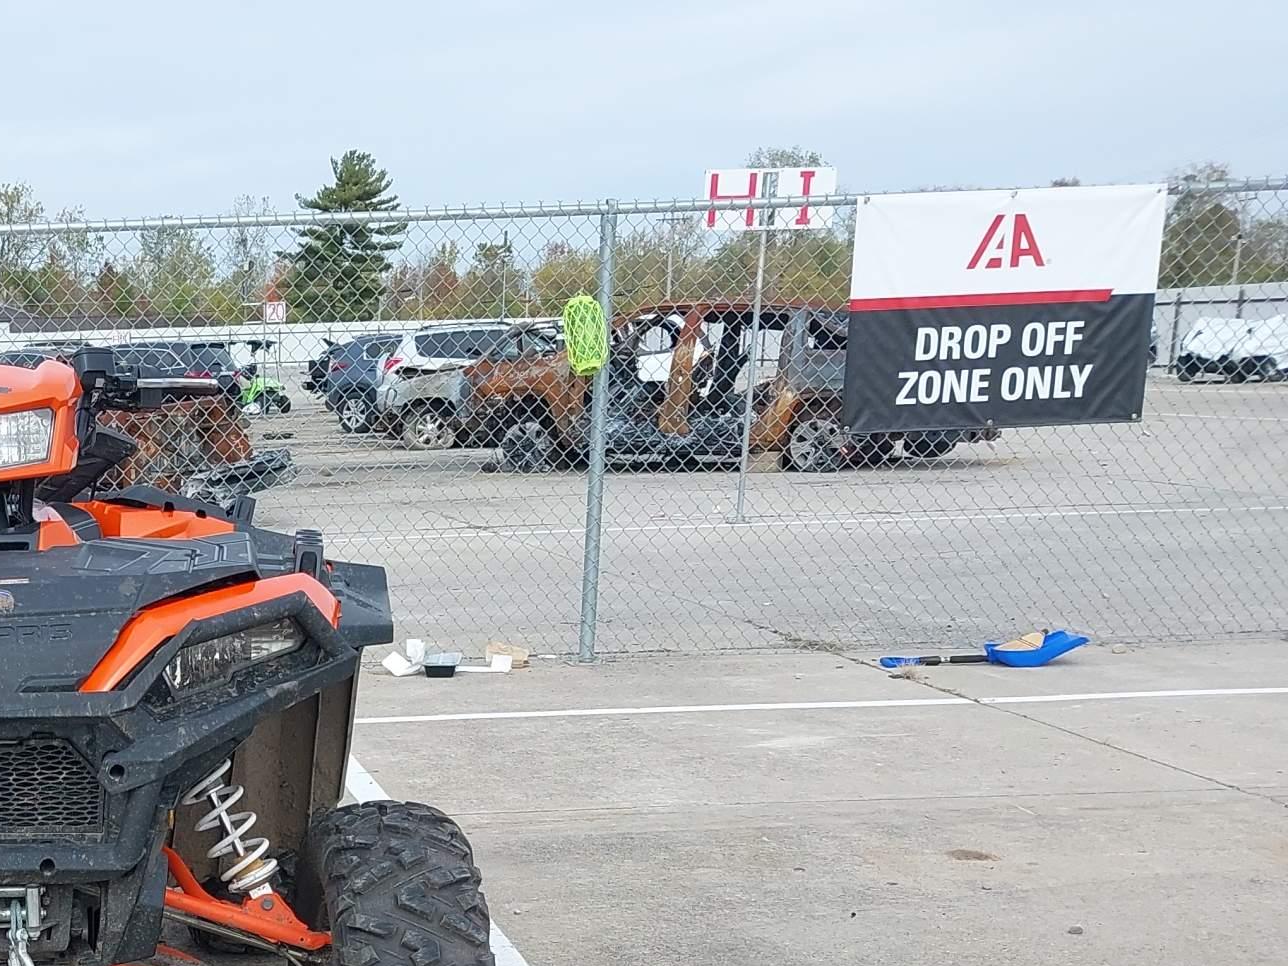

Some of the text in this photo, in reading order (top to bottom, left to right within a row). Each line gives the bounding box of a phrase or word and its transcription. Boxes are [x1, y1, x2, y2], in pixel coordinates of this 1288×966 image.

[915, 320, 1085, 361] DROP OFF
[895, 363, 1094, 406] ZONE ONLY
